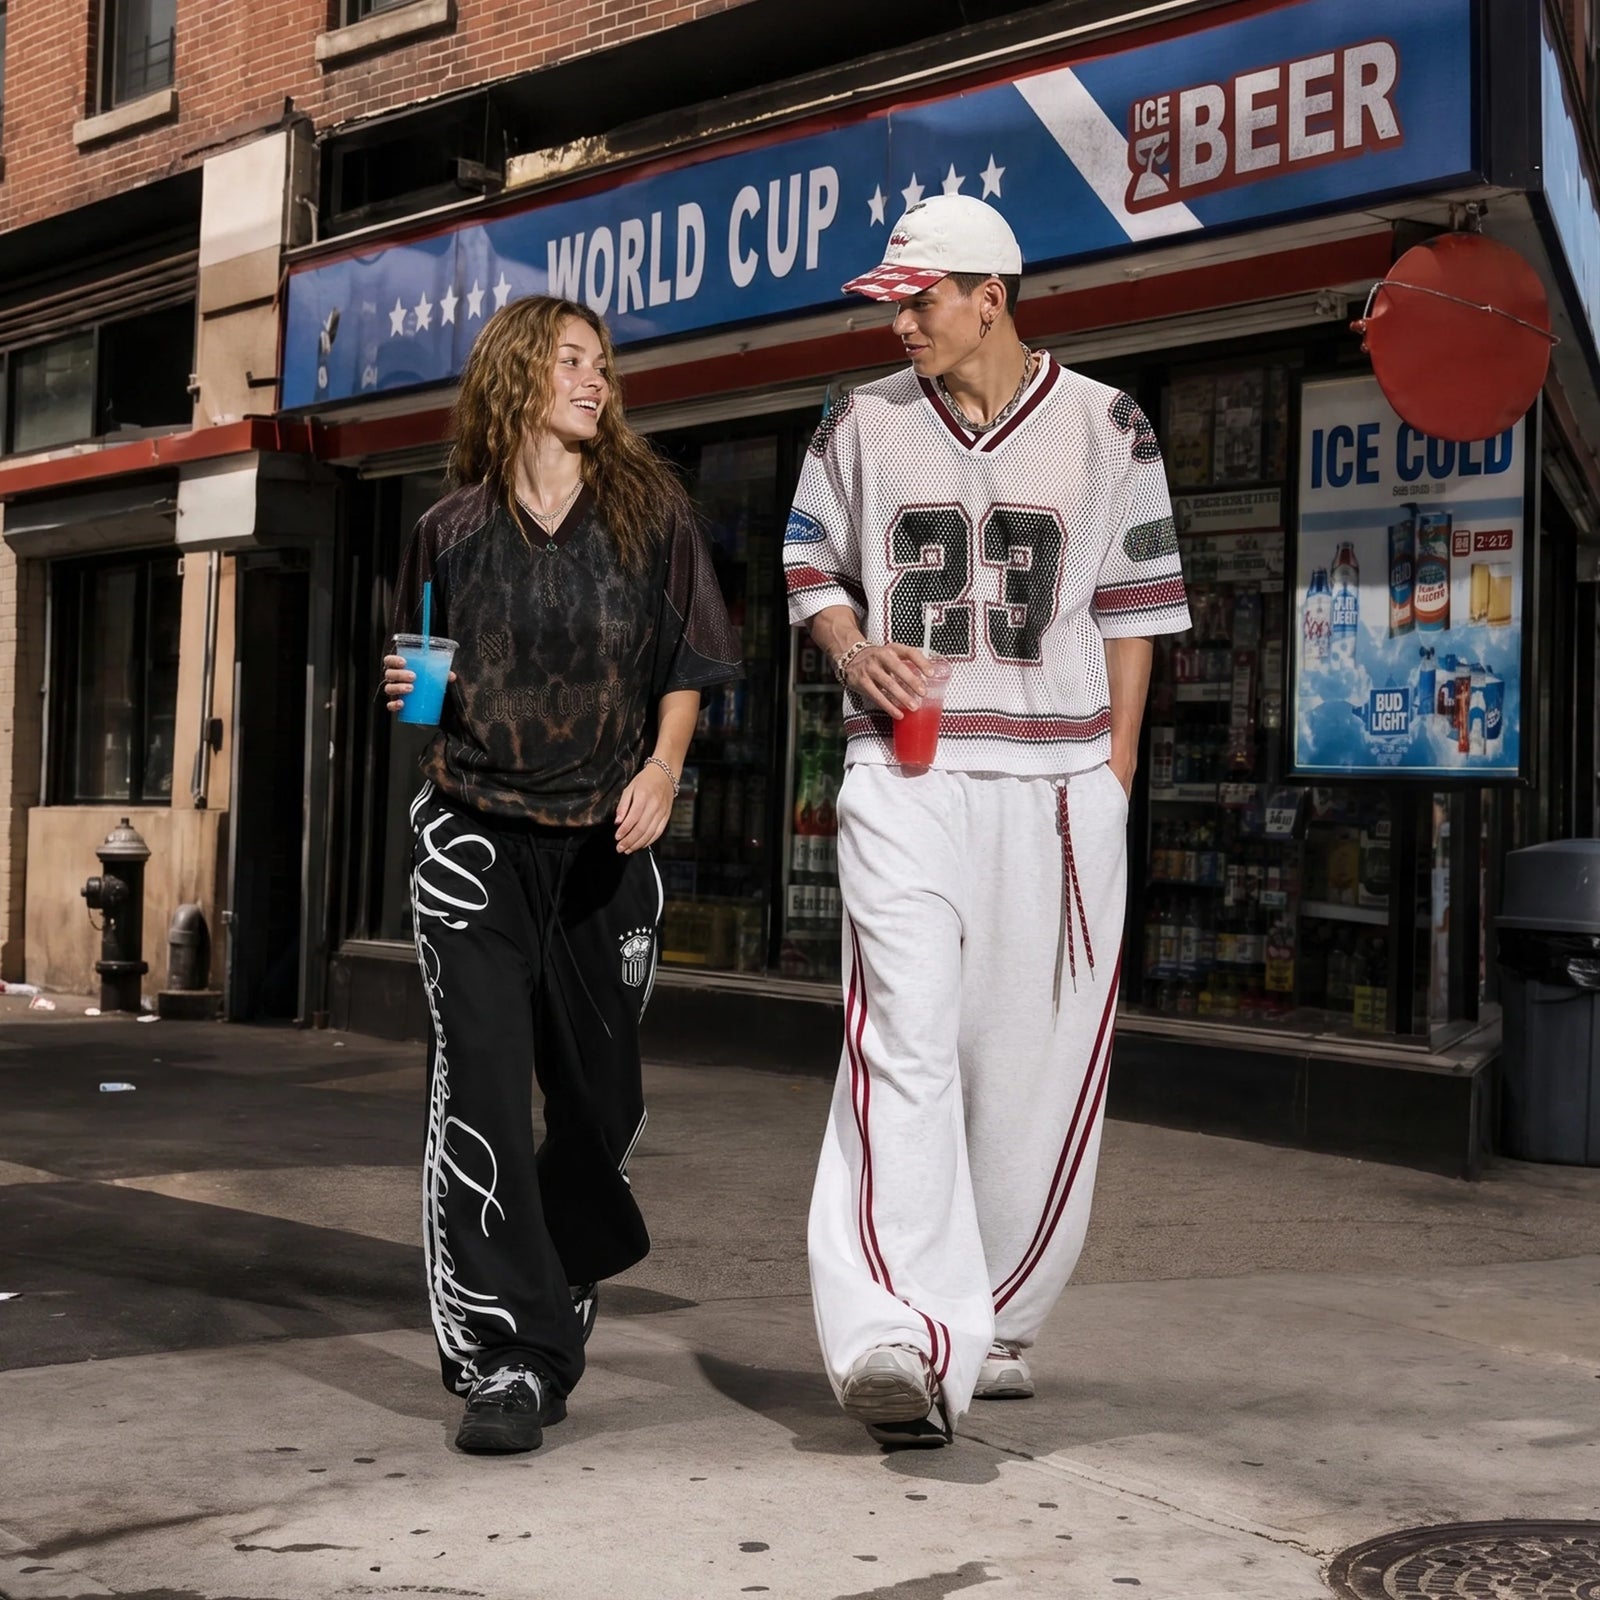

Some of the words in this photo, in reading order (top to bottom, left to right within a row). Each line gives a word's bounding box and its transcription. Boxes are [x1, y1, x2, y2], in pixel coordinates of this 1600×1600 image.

[1134, 96, 1170, 133] ICE
[1178, 41, 1400, 188] BEER
[547, 202, 706, 318] WORLD
[728, 165, 840, 288] CUP
[1311, 422, 1380, 489] ICE
[1396, 421, 1514, 482] COLD
[884, 501, 1069, 668] 23
[1372, 711, 1408, 731] LIGHT
[1375, 692, 1404, 712] BUD
